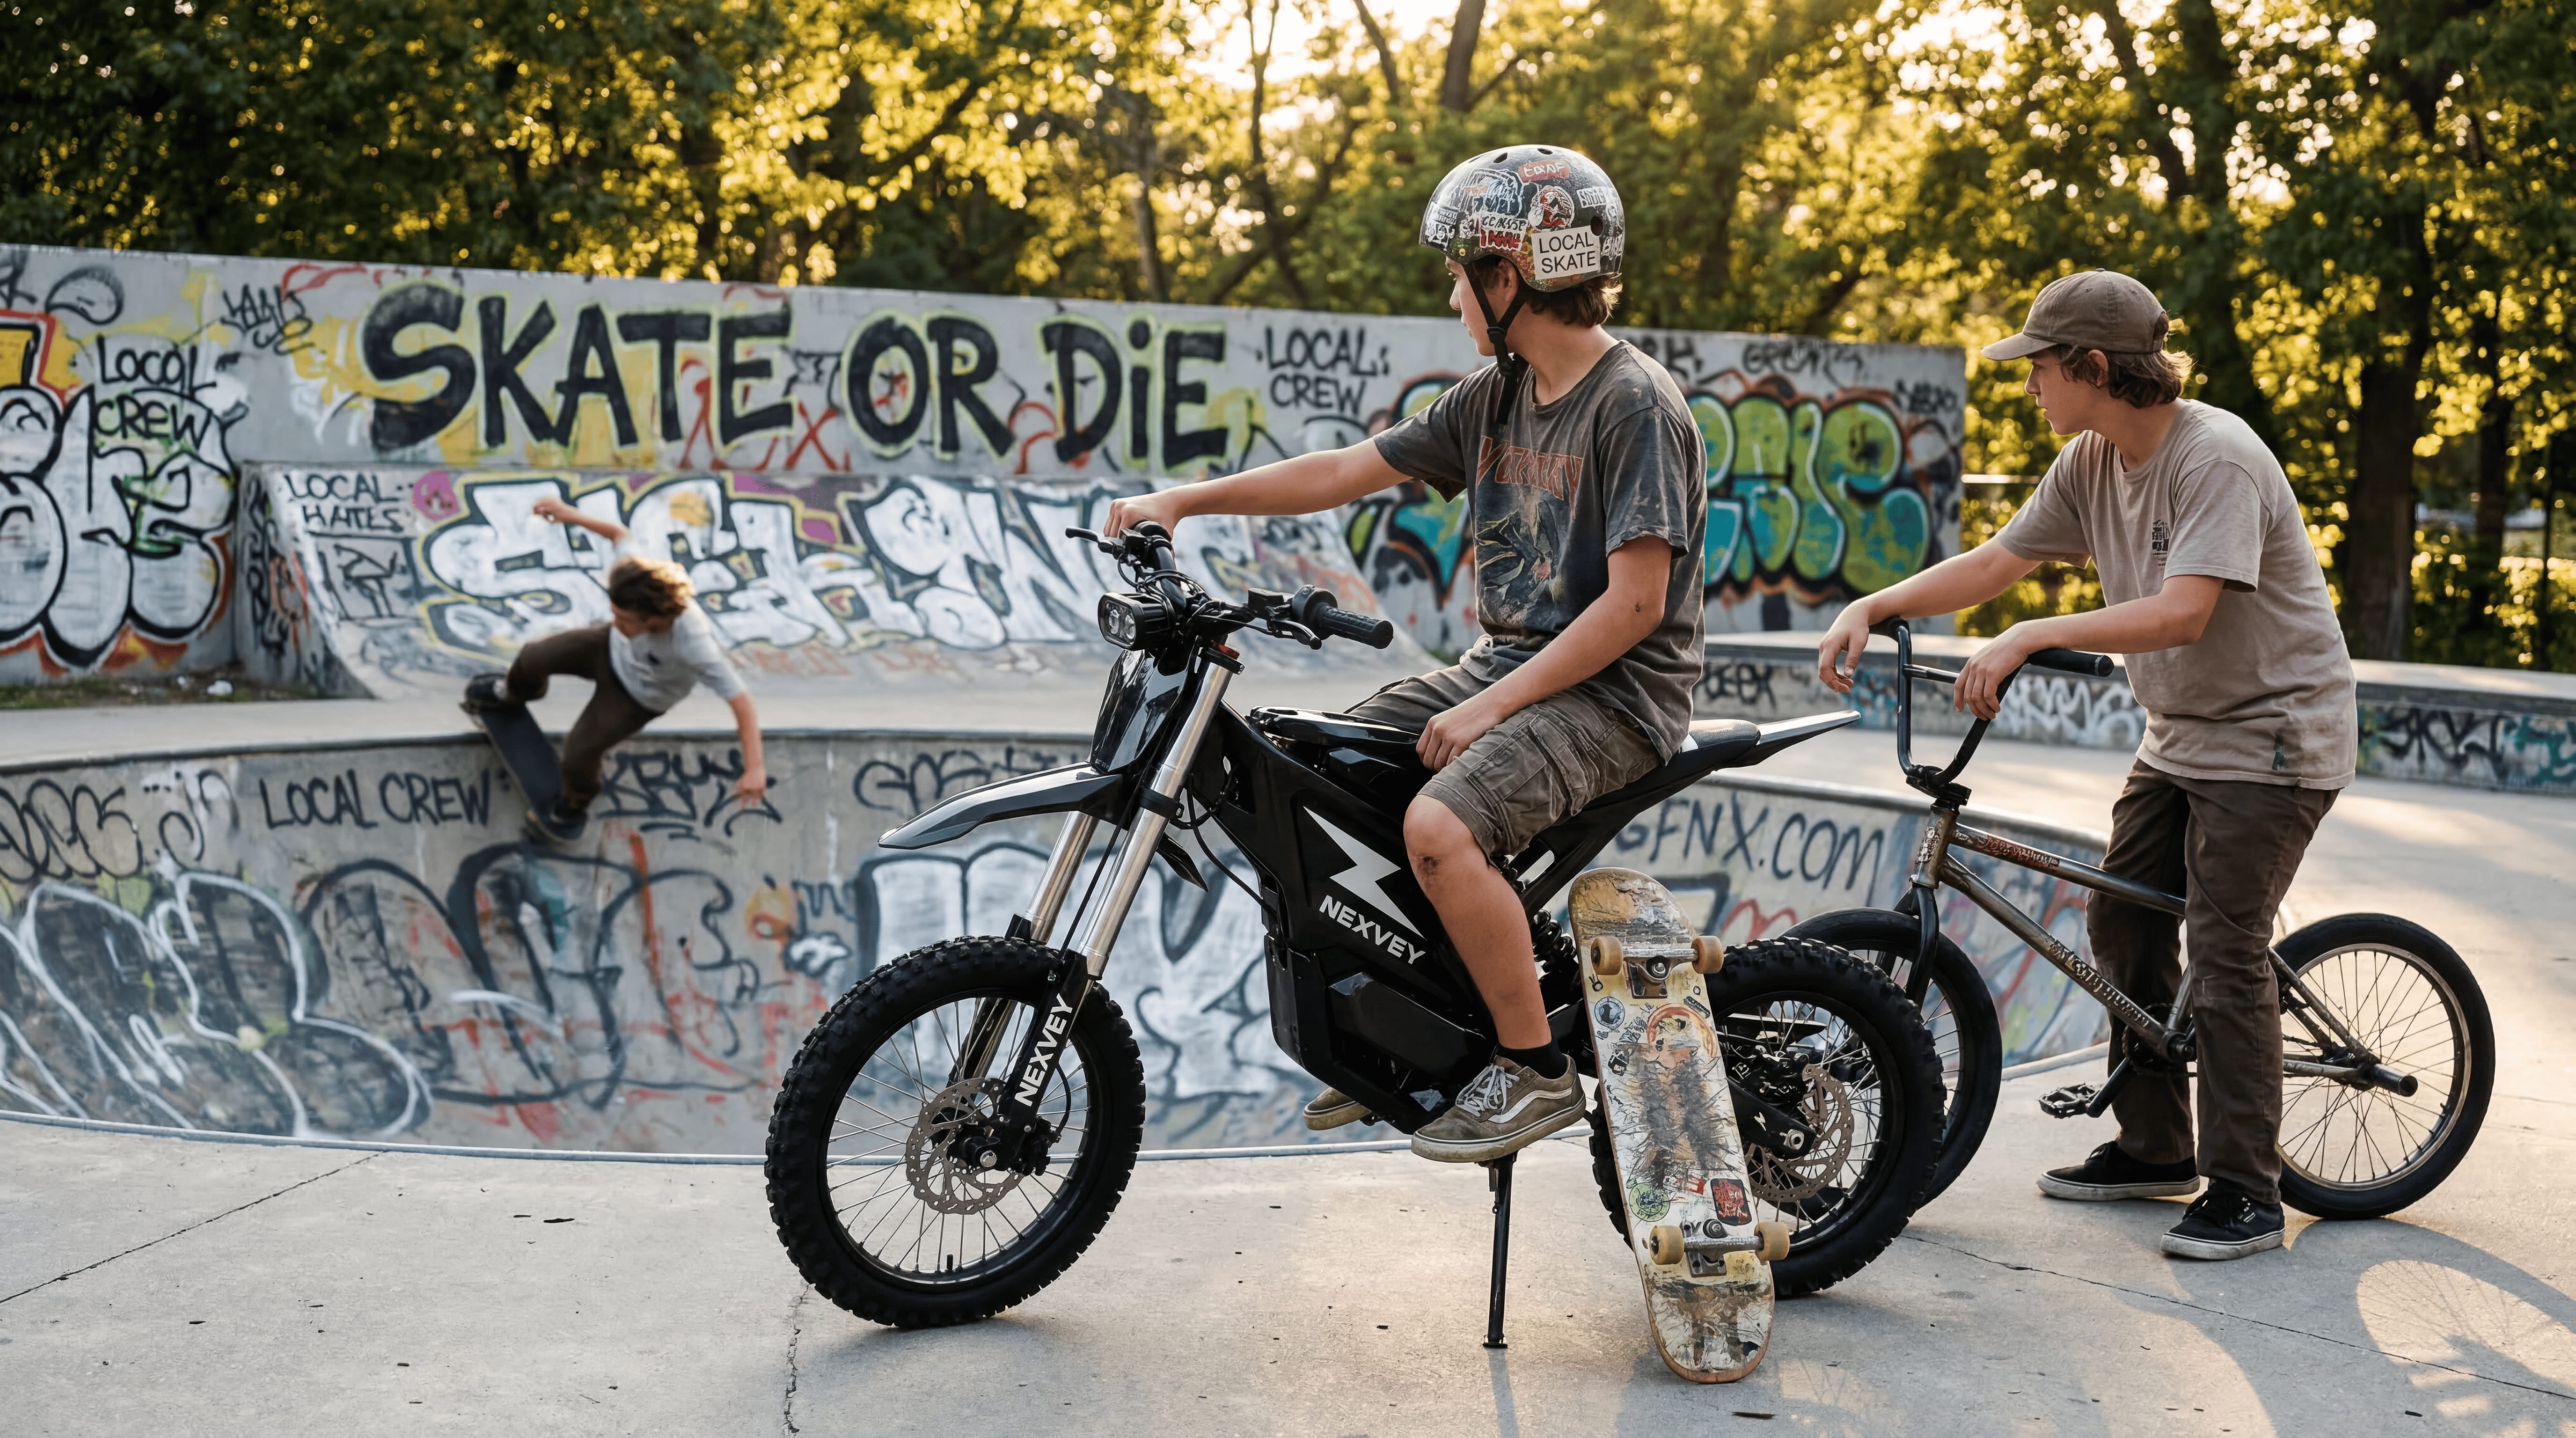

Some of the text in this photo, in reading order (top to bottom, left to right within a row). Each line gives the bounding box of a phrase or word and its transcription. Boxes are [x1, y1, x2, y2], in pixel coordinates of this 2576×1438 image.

[1539, 232, 1594, 253] LOCAL
[1542, 251, 1596, 273] SKATE
[363, 283, 793, 451] SKATE
[848, 315, 1015, 457] OR
[1270, 373, 1367, 416] CREW
[284, 474, 400, 504] LOCAL
[302, 505, 405, 533] HATES
[259, 768, 490, 829] LOCAL CREW
[1319, 895, 1426, 964] NEXVEY
[1014, 993, 1073, 1107] NEXVEY
